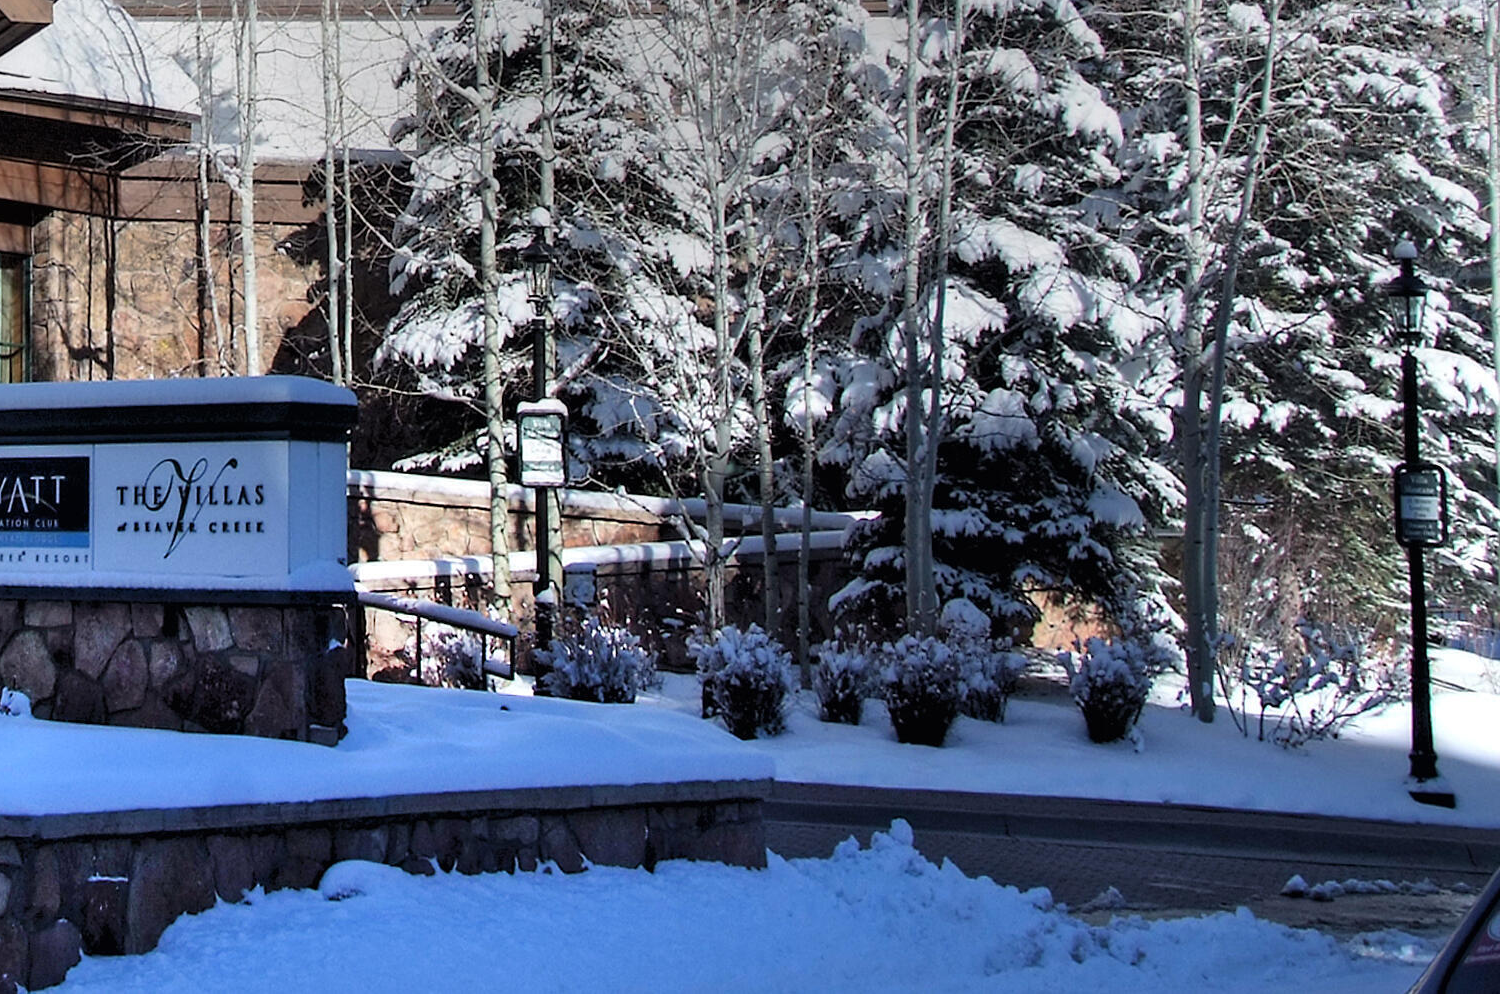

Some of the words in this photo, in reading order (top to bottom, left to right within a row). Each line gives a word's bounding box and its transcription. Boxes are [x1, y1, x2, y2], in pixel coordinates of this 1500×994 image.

[116, 486, 162, 506] THE
[178, 484, 265, 506] VILLAS
[35, 518, 59, 528] CLUB
[133, 522, 197, 533] BEAVER
[209, 522, 265, 534] CREEK
[35, 554, 89, 563] RESORT
